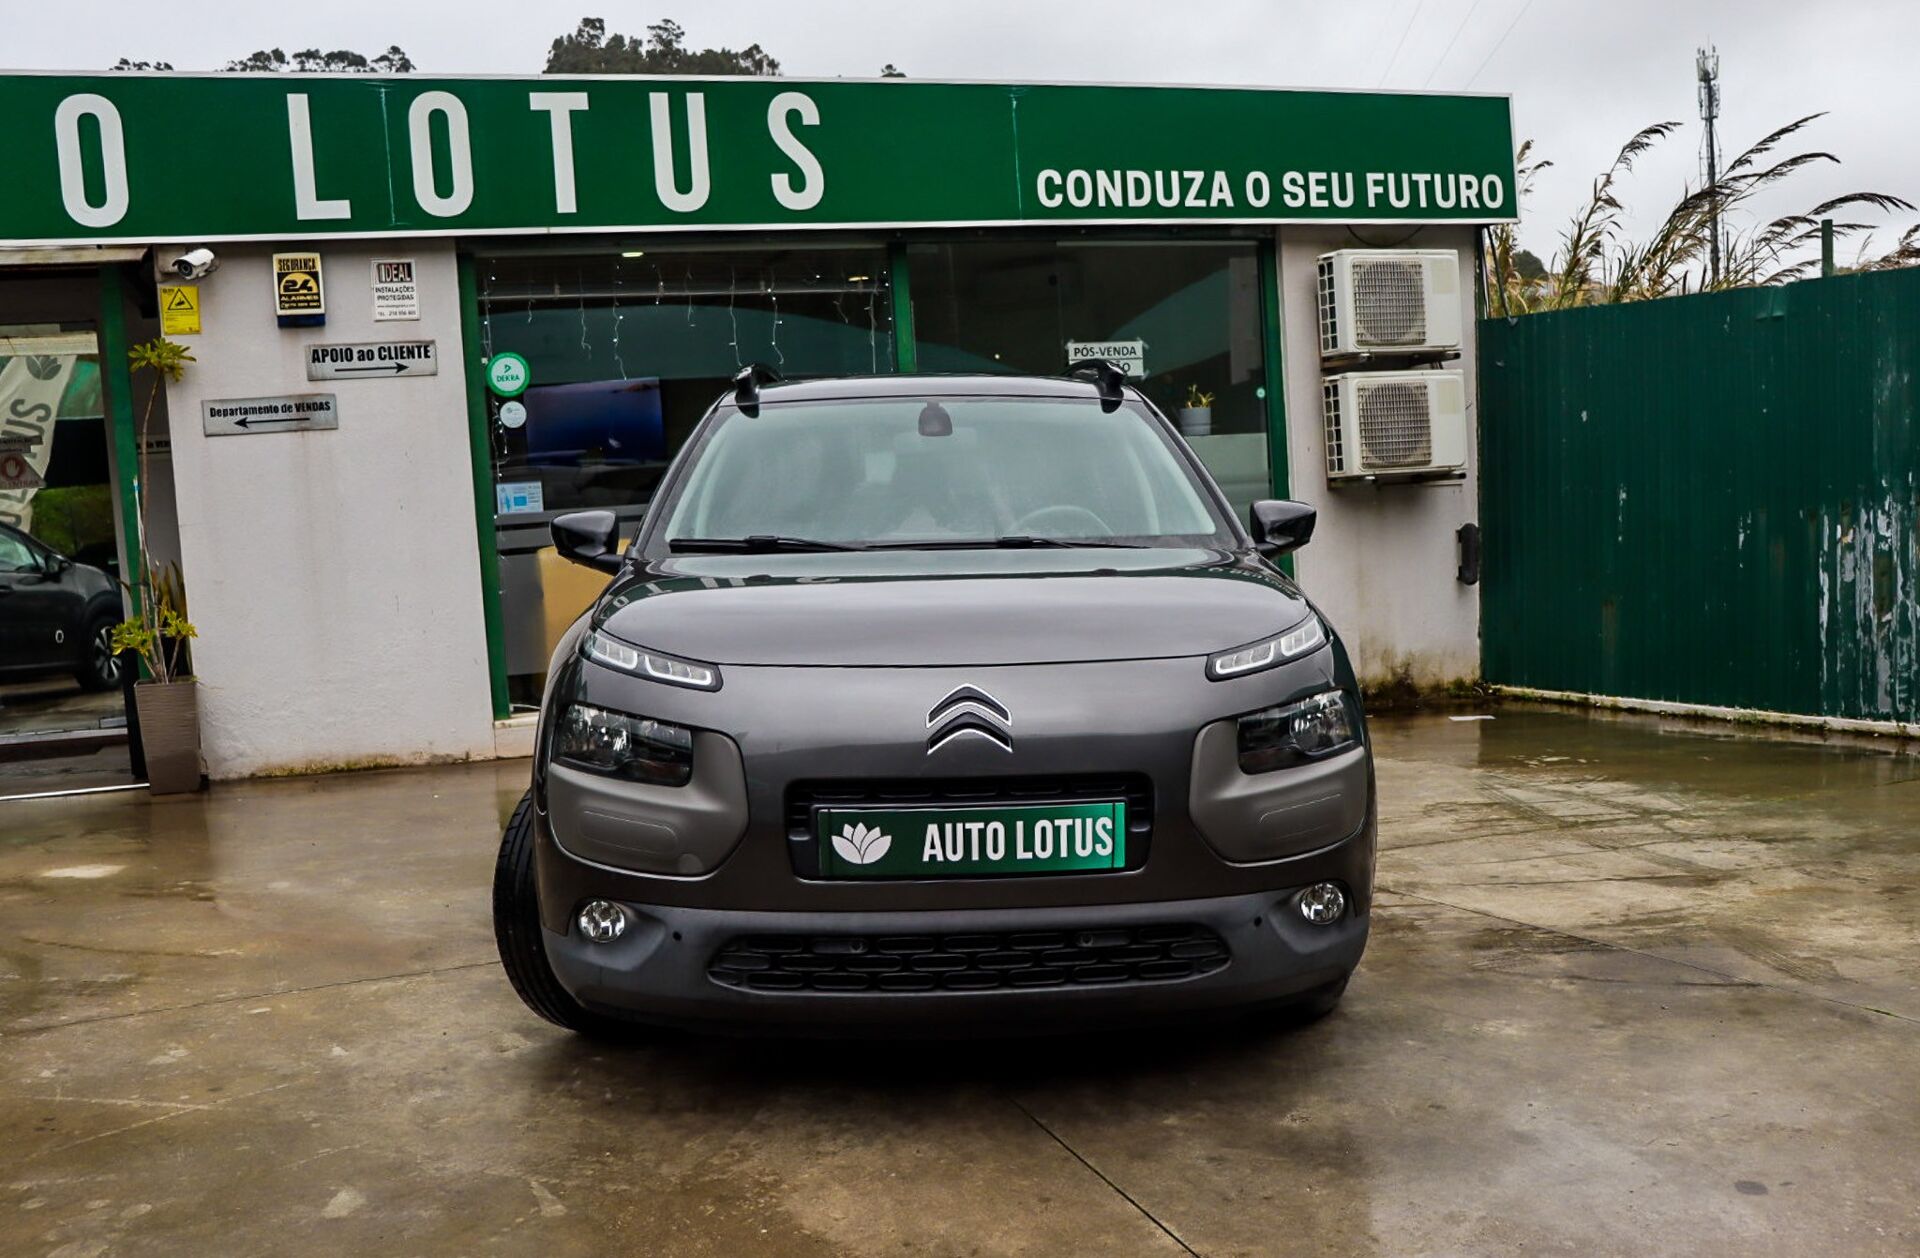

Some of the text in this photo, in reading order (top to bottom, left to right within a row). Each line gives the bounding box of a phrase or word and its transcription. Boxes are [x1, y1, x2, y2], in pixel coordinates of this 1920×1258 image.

[287, 87, 825, 221] LOTUS
[1036, 168, 1504, 208] CONDUZA O SEU FUTURO
[380, 263, 412, 282] IDEAL
[283, 279, 313, 292] 24
[311, 344, 431, 364] APOIO ao CLIENTE
[1074, 345, 1137, 357] PÓS-VENDA
[496, 374, 520, 382] DEKRA
[209, 401, 331, 418] Departamento de VENDAS
[922, 816, 1113, 862] AUTO LOTUS
